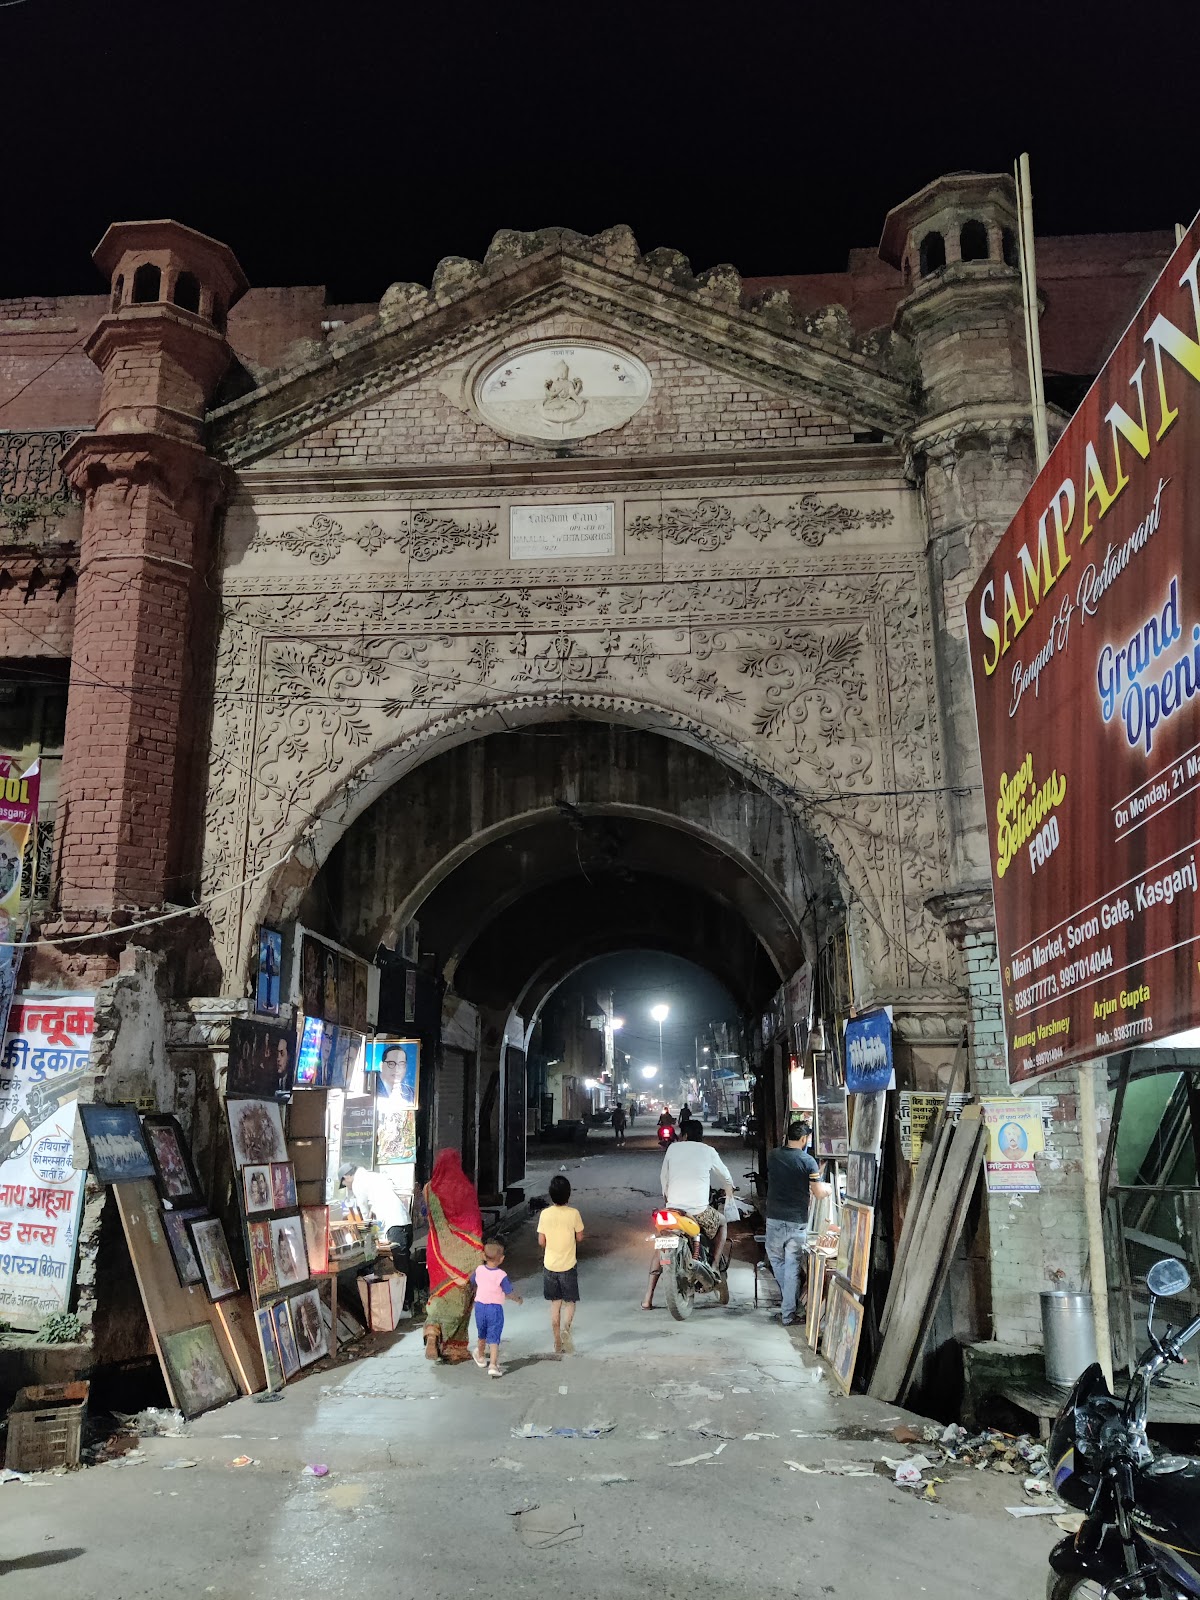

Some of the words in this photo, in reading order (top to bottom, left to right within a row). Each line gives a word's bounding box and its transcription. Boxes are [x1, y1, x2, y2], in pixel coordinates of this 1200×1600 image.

[1009, 613, 1059, 718] Banquet
[1076, 476, 1172, 625] Restaurant
[1096, 574, 1182, 721] Grand
[996, 752, 1034, 827] Super
[1114, 808, 1129, 829] On
[1129, 780, 1171, 820] Monday,
[1171, 763, 1185, 790] 21
[997, 768, 1067, 879] Delicious
[1028, 815, 1060, 875] FOOD
[1012, 950, 1032, 982] Main
[1032, 932, 1067, 969] Market,
[1067, 916, 1100, 950] Soron
[1101, 898, 1134, 930] Gate,
[1135, 854, 1198, 913] Kasganj
[1059, 944, 1113, 988] 9997014044
[1013, 1027, 1037, 1050] Anurag
[1036, 1016, 1070, 1040] Varshney
[1093, 995, 1118, 1021] Arjun
[1119, 984, 1151, 1006] Gupta
[17, 1222, 57, 1246] सन्स
